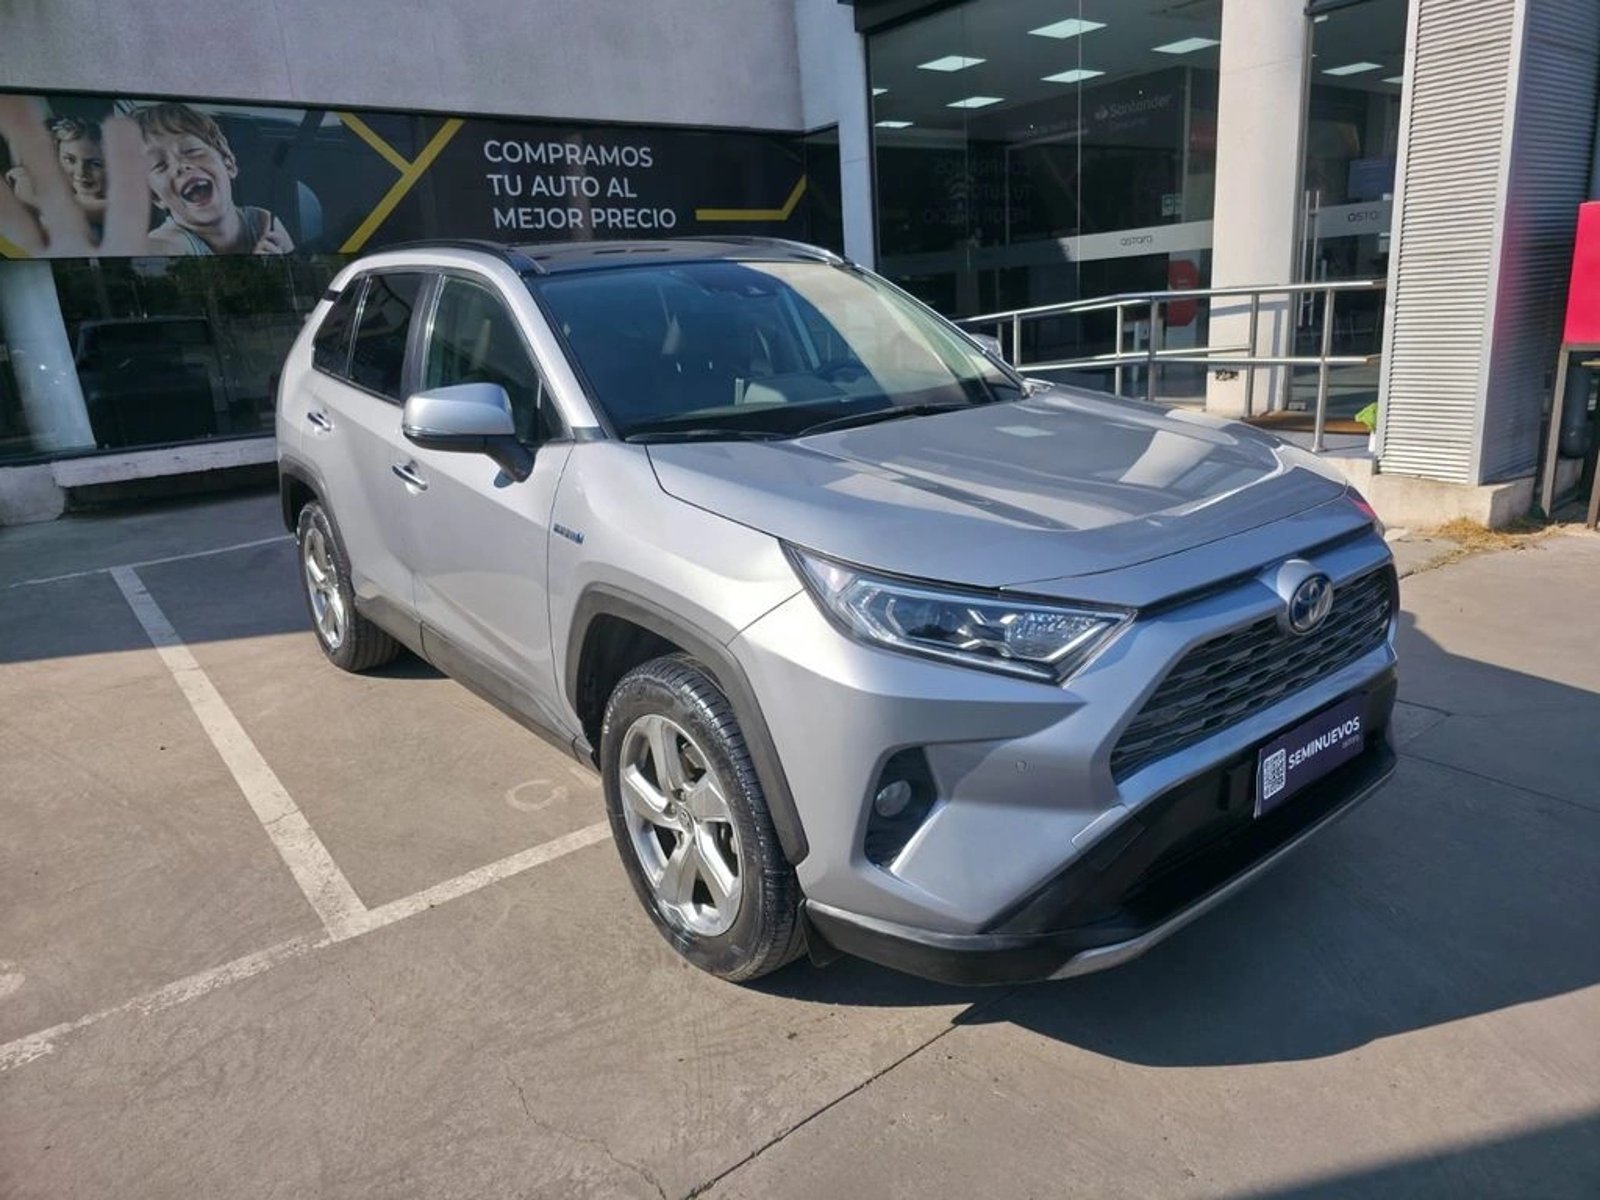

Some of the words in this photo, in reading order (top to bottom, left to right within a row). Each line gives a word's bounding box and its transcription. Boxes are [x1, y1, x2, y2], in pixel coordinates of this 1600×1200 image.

[1109, 94, 1173, 116] Santander
[484, 140, 652, 167] COMPRAMOS
[487, 174, 522, 196] TU
[531, 175, 600, 198] AUTO
[607, 177, 637, 198] AL
[493, 208, 583, 229] MEJOR
[591, 208, 676, 229] PRECIO
[1288, 716, 1361, 769] SEMINUEVOS
